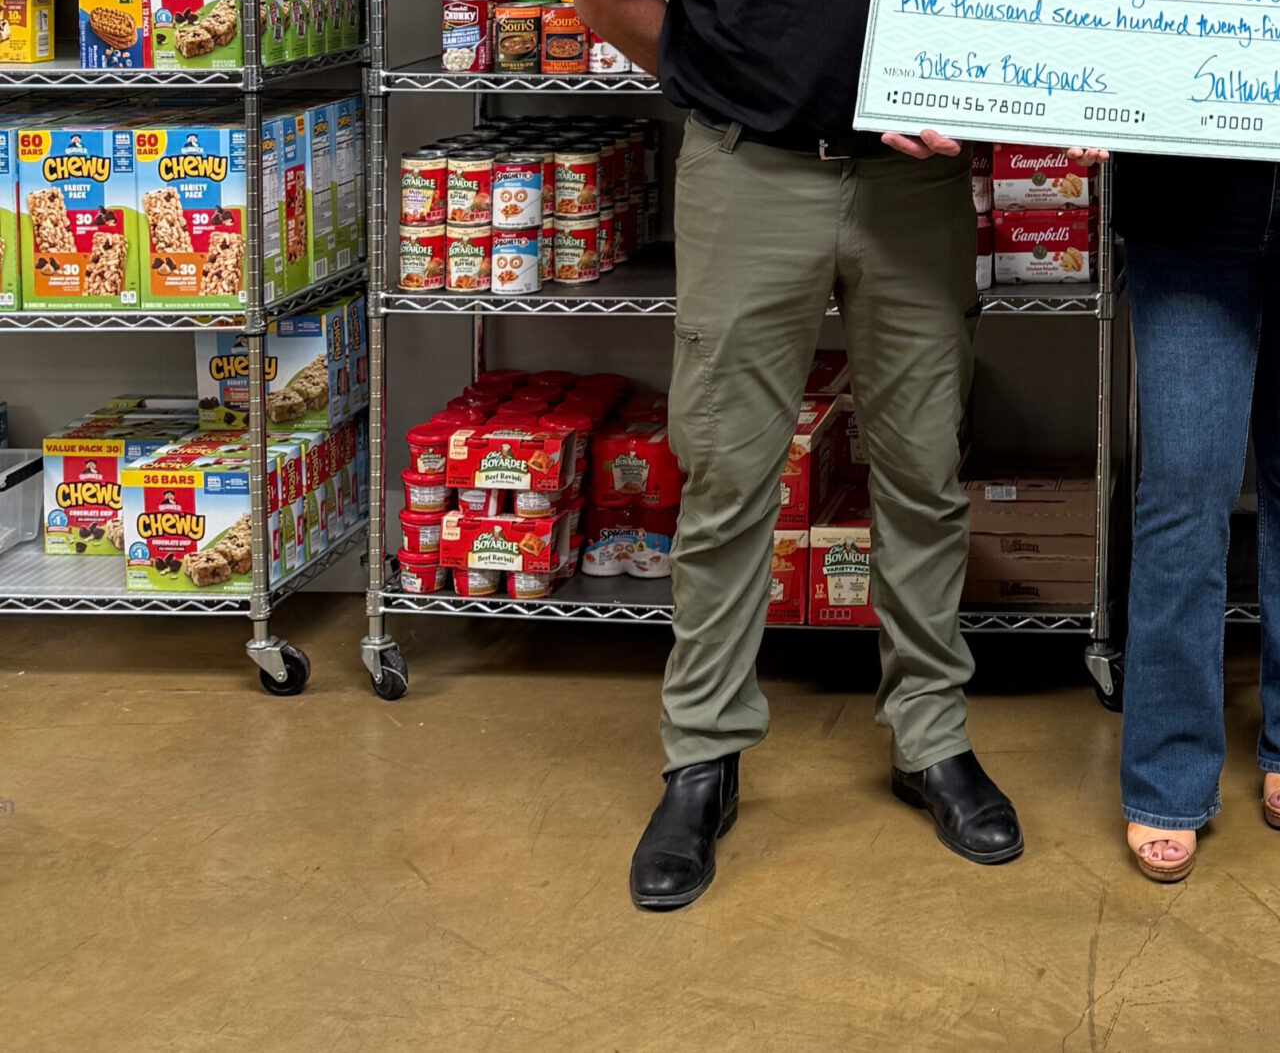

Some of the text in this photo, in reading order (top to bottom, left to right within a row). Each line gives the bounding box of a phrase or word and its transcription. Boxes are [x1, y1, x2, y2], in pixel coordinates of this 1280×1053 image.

[1052, 6, 1111, 27] seven
[1117, 7, 1191, 36] hundred
[915, 51, 1107, 96] Bites for Backpacks
[21, 135, 43, 147] 60
[136, 135, 158, 147] 60
[20, 147, 44, 156] BARS
[135, 147, 159, 156] BARS
[44, 156, 109, 181] CHEWY
[160, 156, 224, 181] CHEWY
[76, 214, 92, 224] 30
[192, 214, 208, 224] 30
[1011, 227, 1069, 244] Campbell's
[63, 265, 79, 275] 30
[178, 265, 194, 275] 30
[45, 443, 104, 453] VALUE PACK
[481, 459, 527, 472] BOYARDEE
[143, 474, 195, 485] 36 BARS
[484, 472, 523, 483] Beef Ravioli
[137, 514, 204, 538] CHEWY
[473, 541, 519, 553] BOYARDEE
[477, 554, 516, 565] Beef Ravioli
